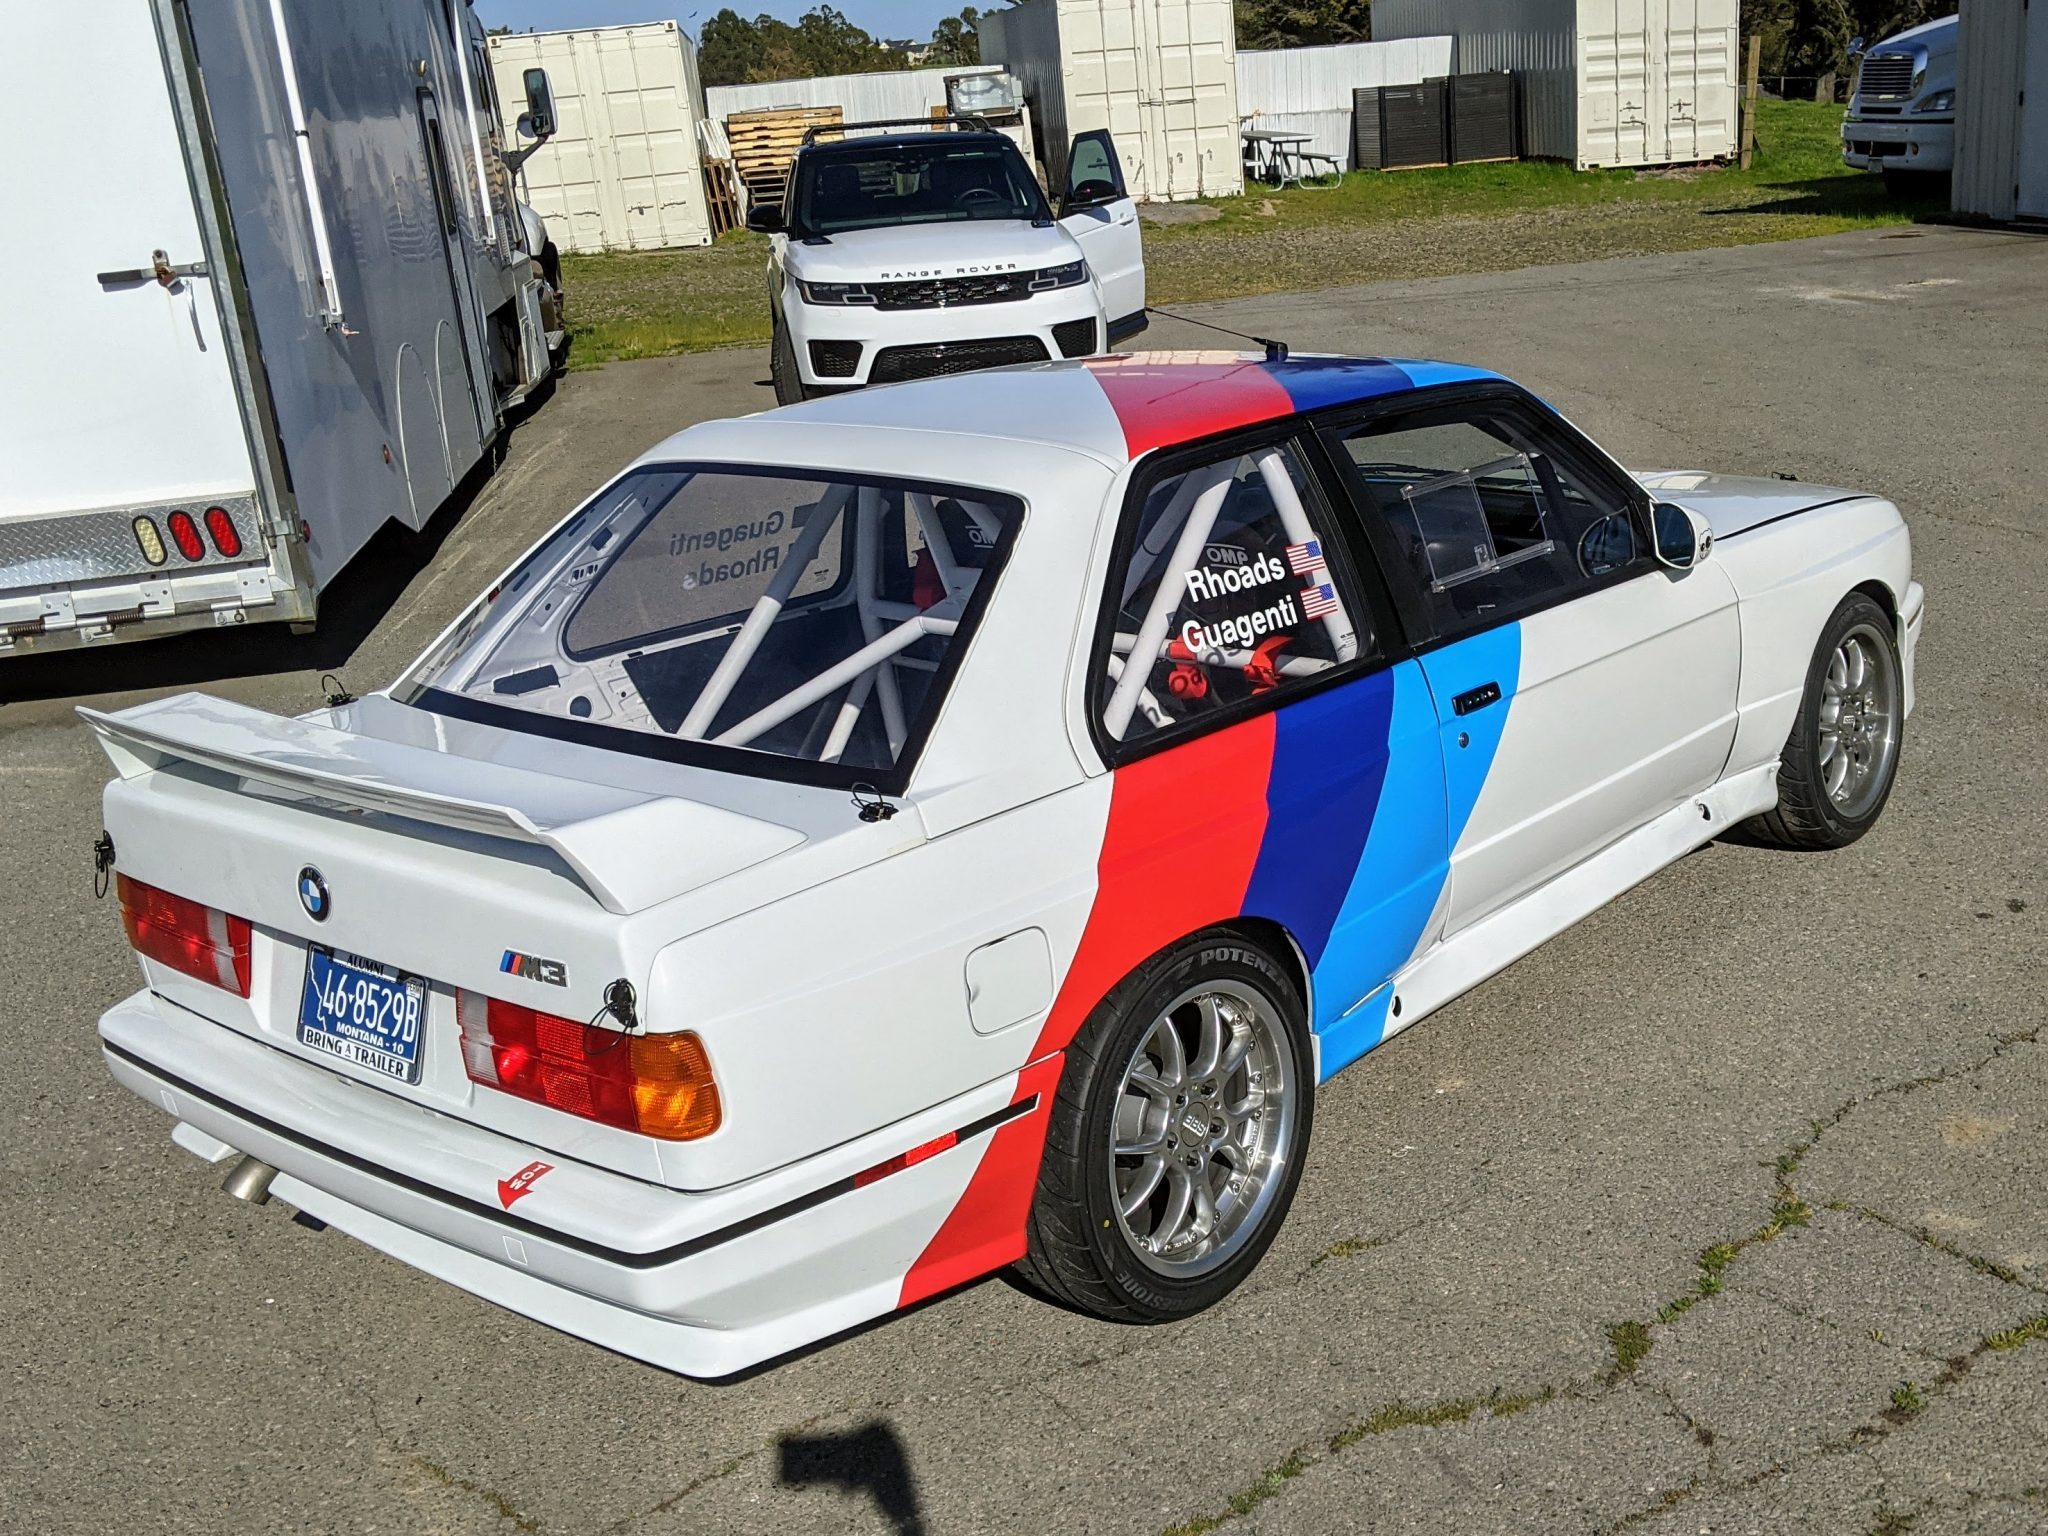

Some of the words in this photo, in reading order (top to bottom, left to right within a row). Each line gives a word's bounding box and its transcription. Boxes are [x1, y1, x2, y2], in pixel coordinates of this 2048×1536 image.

[881, 270, 942, 279] RANGE
[956, 263, 1016, 274] ROVER
[1206, 547, 1249, 566] OMP
[1184, 552, 1286, 603] Rhoads
[1182, 594, 1299, 653] Guagenti
[347, 954, 385, 975] ALUMNI
[517, 953, 568, 988] M3
[1201, 947, 1289, 994] POTENZA
[306, 1029, 342, 1054] BRING
[345, 1045, 352, 1056] A
[354, 1046, 404, 1077] TRAILER
[336, 1022, 384, 1047] MONTANA
[392, 1042, 404, 1055] 10
[1183, 1115, 1206, 1136] BBS
[509, 1164, 547, 1190] TOW
